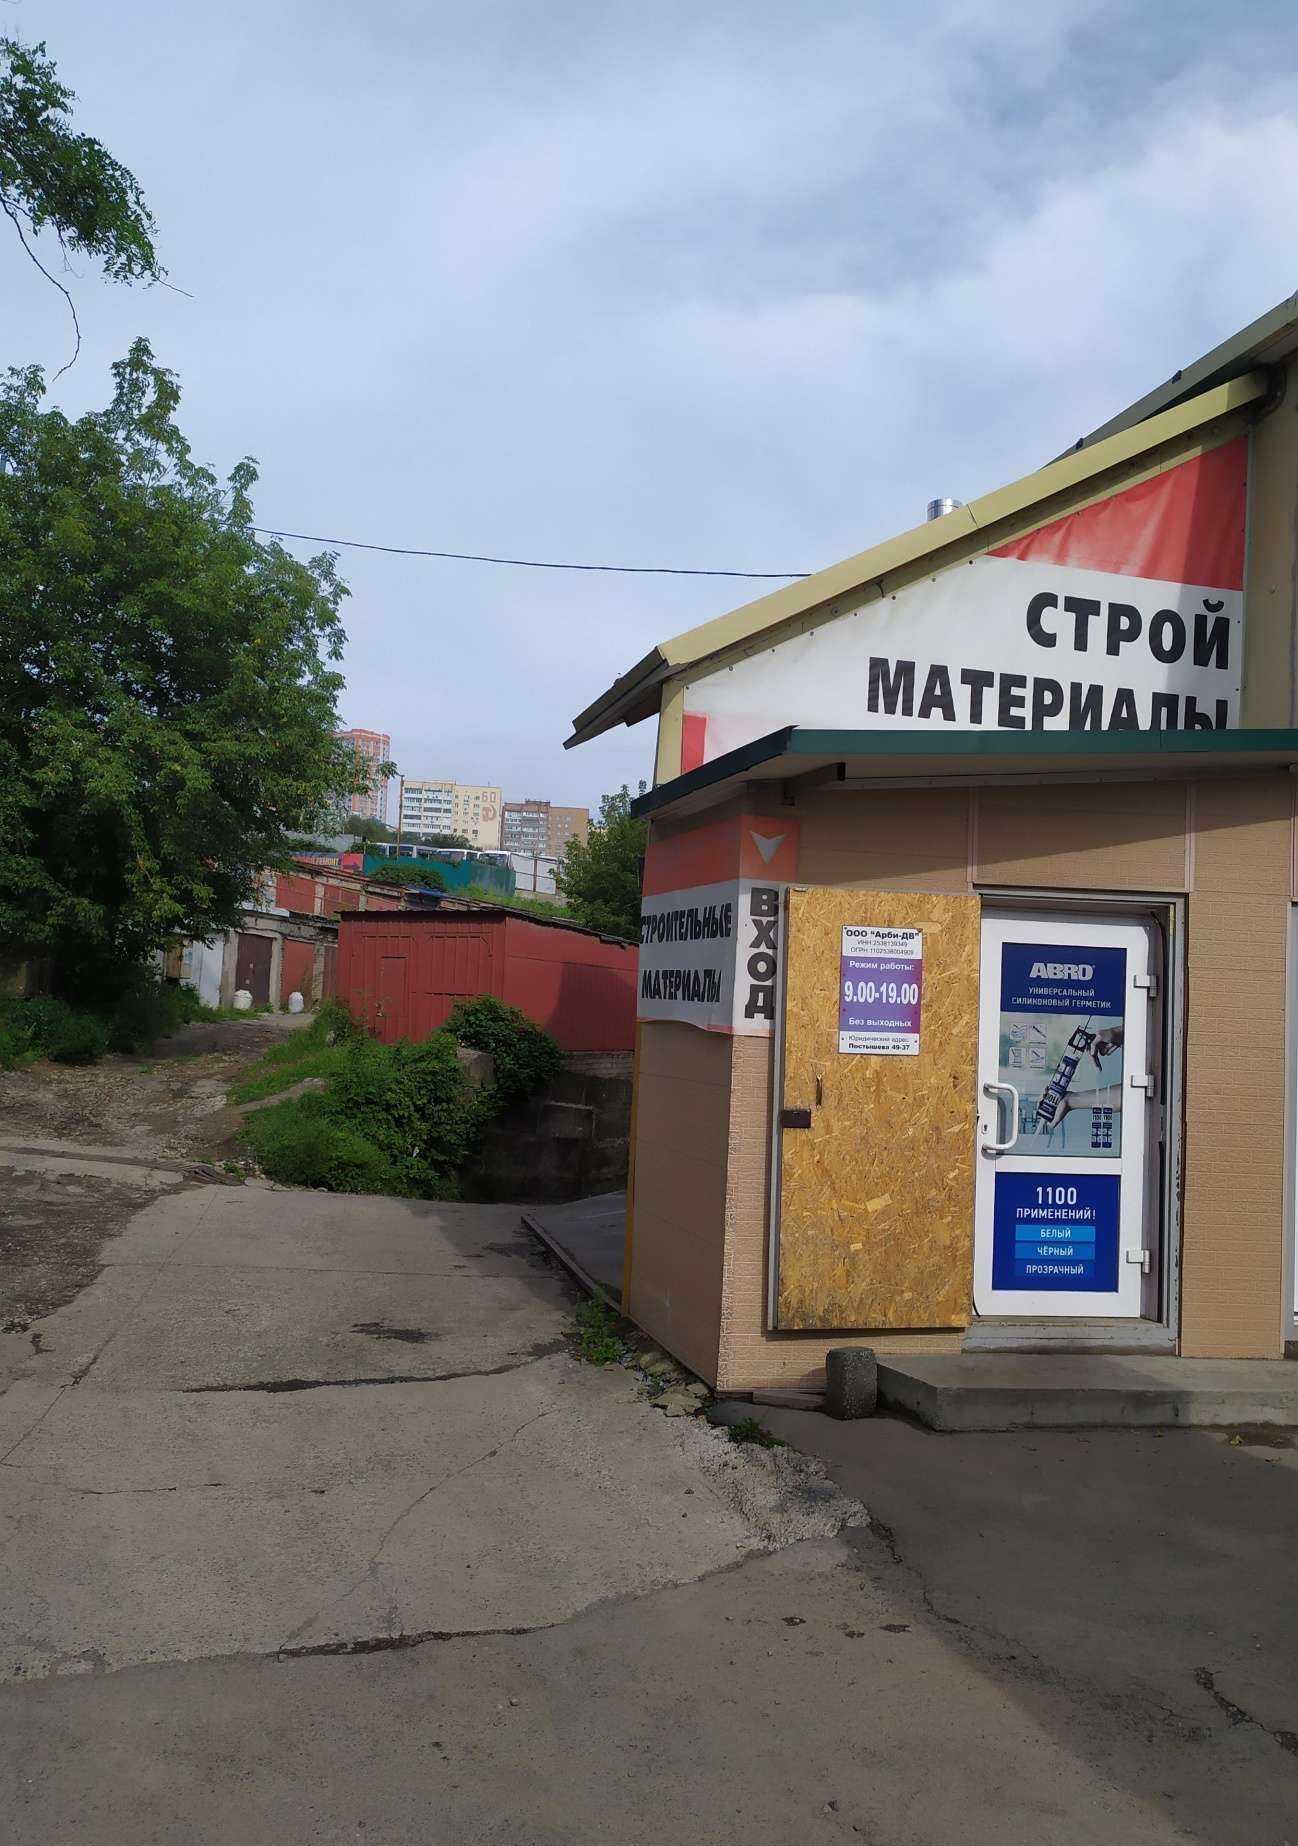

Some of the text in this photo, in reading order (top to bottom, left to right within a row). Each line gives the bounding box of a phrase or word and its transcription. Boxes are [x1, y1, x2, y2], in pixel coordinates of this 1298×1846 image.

[1026, 592, 1230, 670] СТРОЙ
[867, 656, 1228, 731] МАТЕРИАЛЫ
[845, 929, 868, 938] ООО
[744, 887, 779, 1020] ВХОД
[849, 960, 915, 972] Режим работы:
[1029, 962, 1094, 981] ABRO
[641, 968, 722, 1003] МАТЕРИАЛЫ
[1028, 986, 1095, 998] УНИВЕРСАЛЬНЫЙ
[844, 981, 919, 1005] 9.00-19.00
[1011, 996, 1112, 1010] СИЛИКОНОВЫЙ ГЕРМЕТИК
[848, 1017, 913, 1028] Без выходных
[1036, 1186, 1077, 1205] 1100
[1016, 1207, 1096, 1220] ПРИМЕНЕНИЙ!
[1040, 1227, 1071, 1238] БЕЛЫЙ
[1037, 1245, 1074, 1256] ЧЁРНЫЙ
[1026, 1263, 1084, 1275] ПРОЗРАЧНЫЙ
